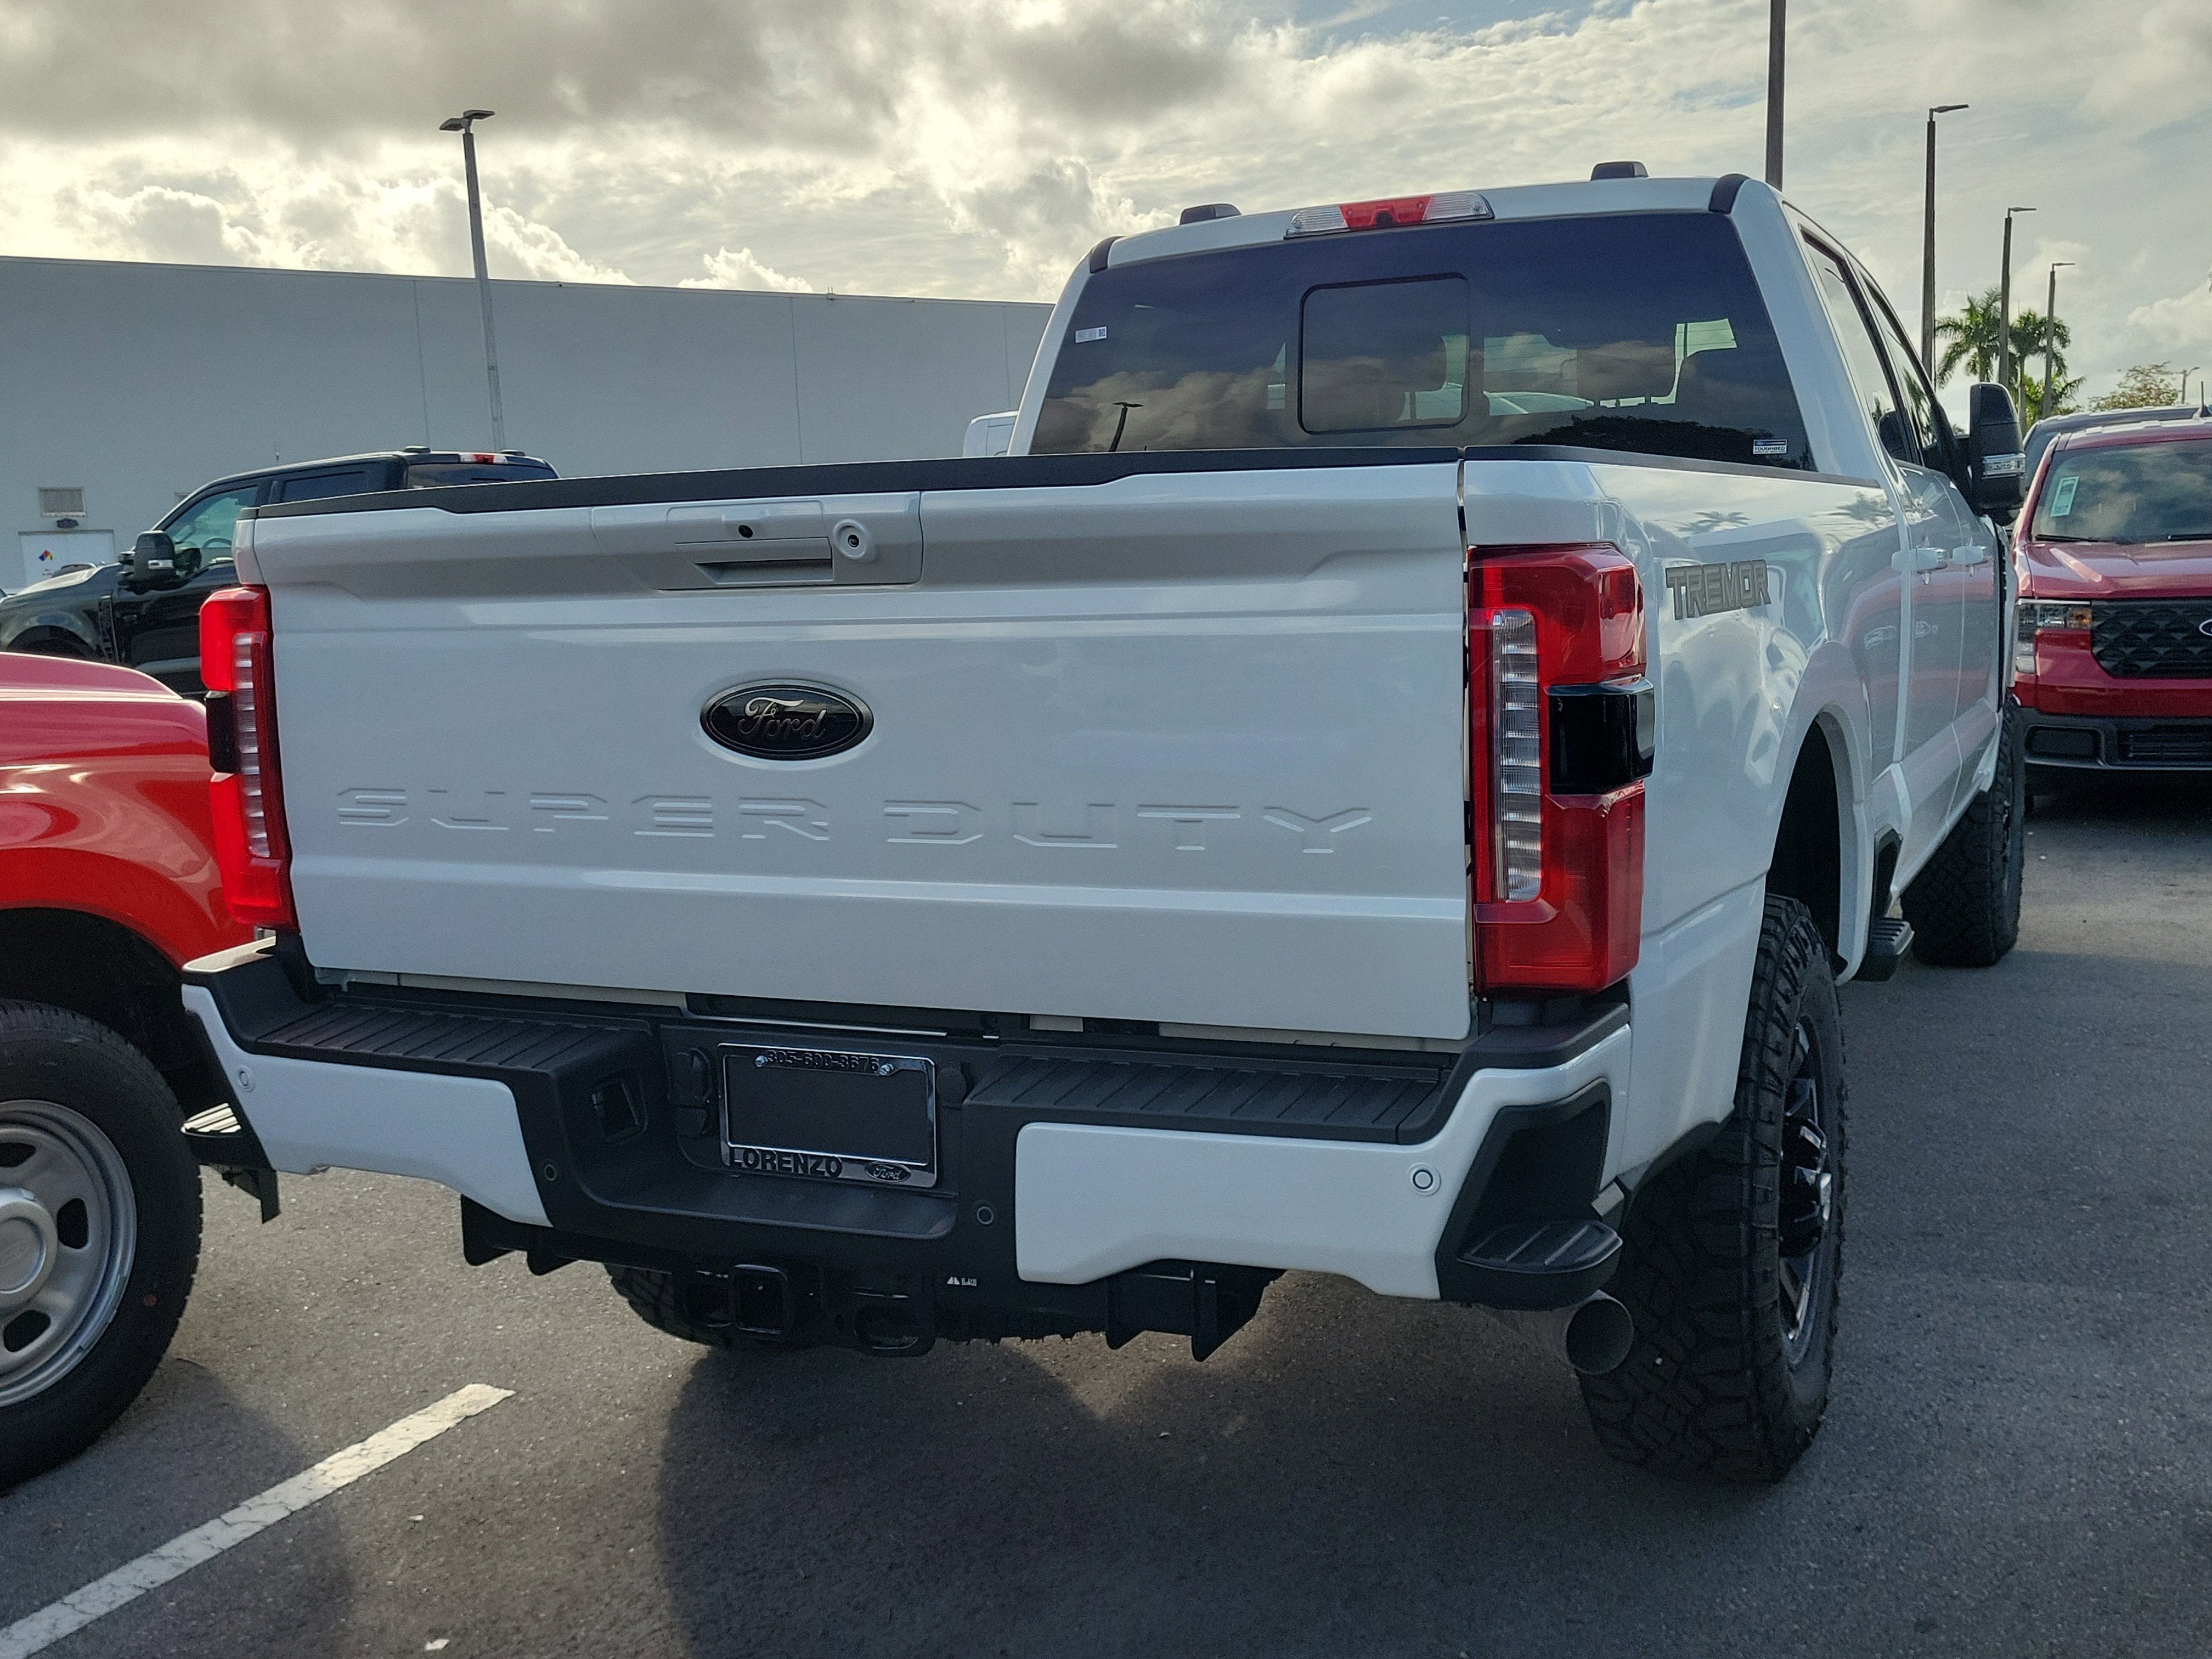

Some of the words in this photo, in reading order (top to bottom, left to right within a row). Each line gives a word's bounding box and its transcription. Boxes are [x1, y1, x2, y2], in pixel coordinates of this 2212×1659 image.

[1665, 559, 1771, 620] TREMOR
[737, 697, 827, 737] Ford
[337, 788, 830, 841] SUPER
[883, 799, 1372, 853] DUTY
[729, 1148, 843, 1178] LORENZO
[873, 1164, 902, 1180] Ford
